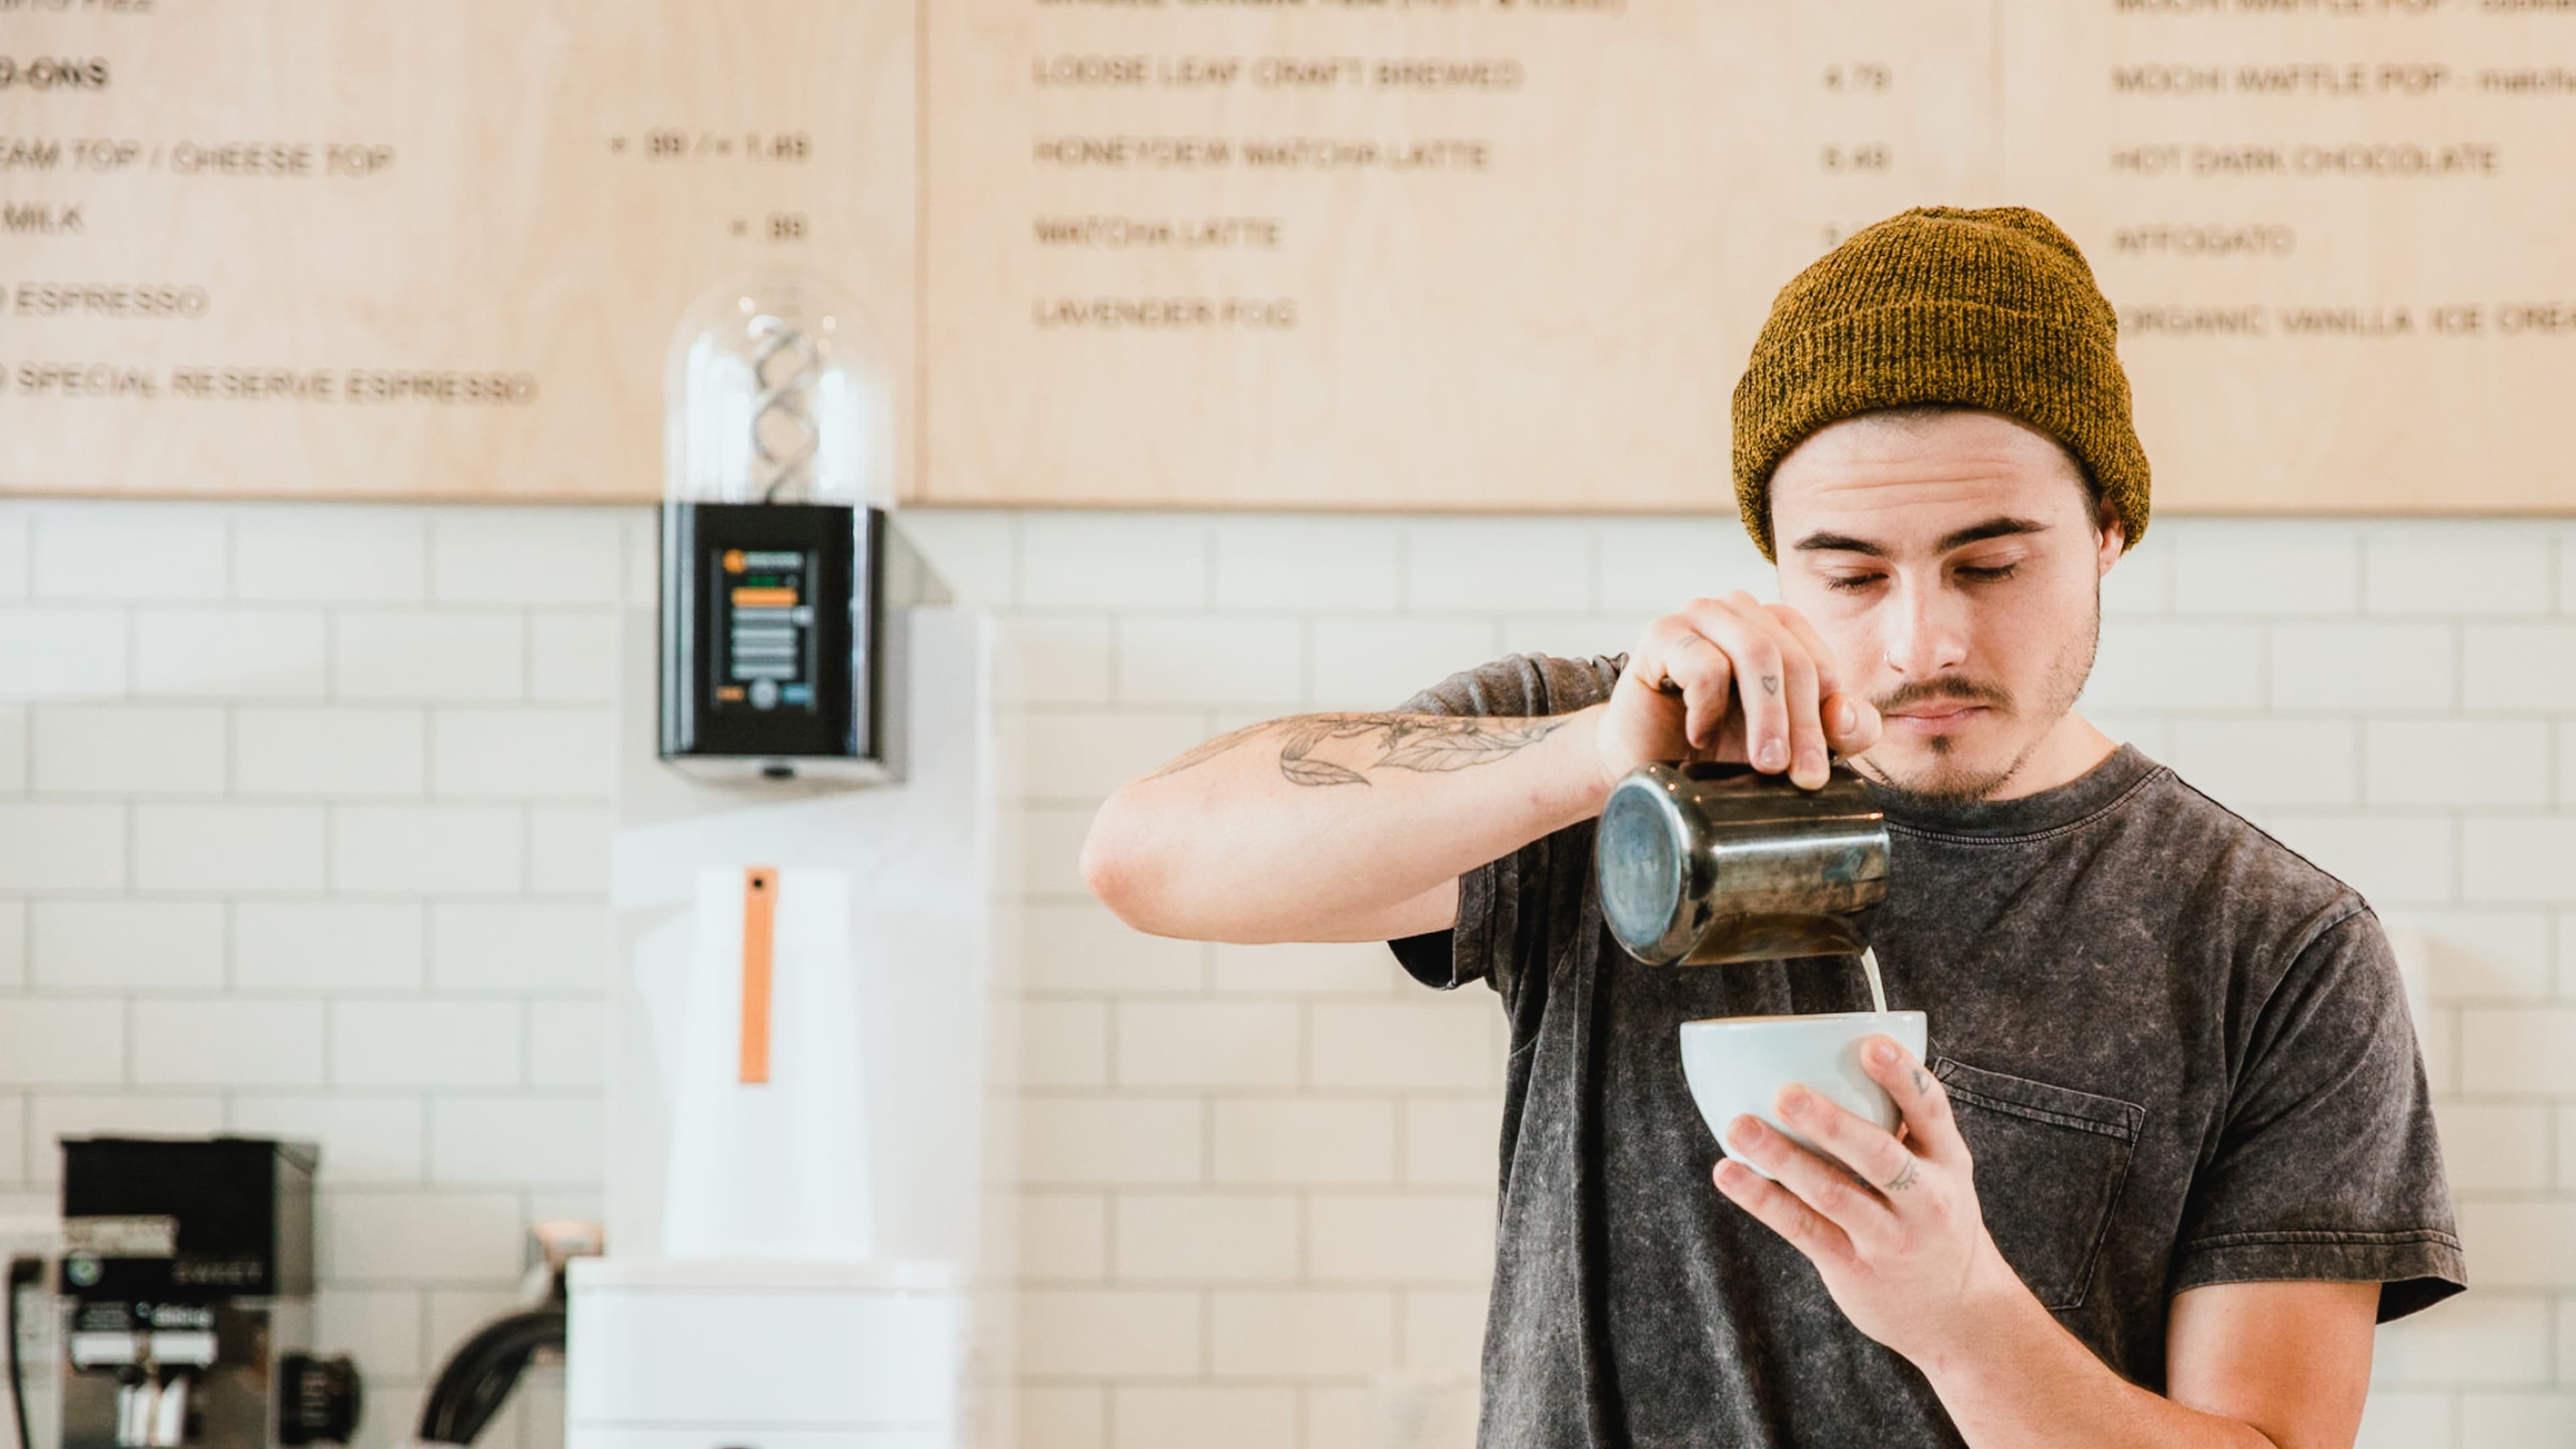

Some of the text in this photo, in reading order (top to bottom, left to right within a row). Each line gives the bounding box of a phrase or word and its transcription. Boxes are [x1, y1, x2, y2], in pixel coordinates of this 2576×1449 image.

[1032, 56, 1524, 91] LOOSE LEAF CRAFT BREWED
[2110, 63, 2227, 96] MOCHI
[2233, 63, 2368, 97] WAFFLE
[2374, 63, 2452, 97] POP
[70, 138, 143, 172] TOP
[171, 140, 313, 177] CHEESE
[323, 142, 396, 177] TOP
[1032, 137, 1234, 170] HONEYDEW
[1381, 139, 1491, 172] LATTE
[2110, 143, 2500, 178] HOT DARK CHOCOLATE
[1175, 217, 1281, 250] LATTE
[2111, 223, 2295, 257] AFFOGATO
[14, 282, 209, 319] ESPRESSO
[1032, 297, 1297, 330] LAVENDER FOG
[2118, 305, 2267, 337] ORGANIC
[2277, 306, 2416, 338] VANILLA
[2429, 304, 2485, 337] ICE
[16, 363, 160, 401] SPECIAL
[170, 367, 335, 402] RESERVE
[343, 369, 539, 406] ESPRESSO
